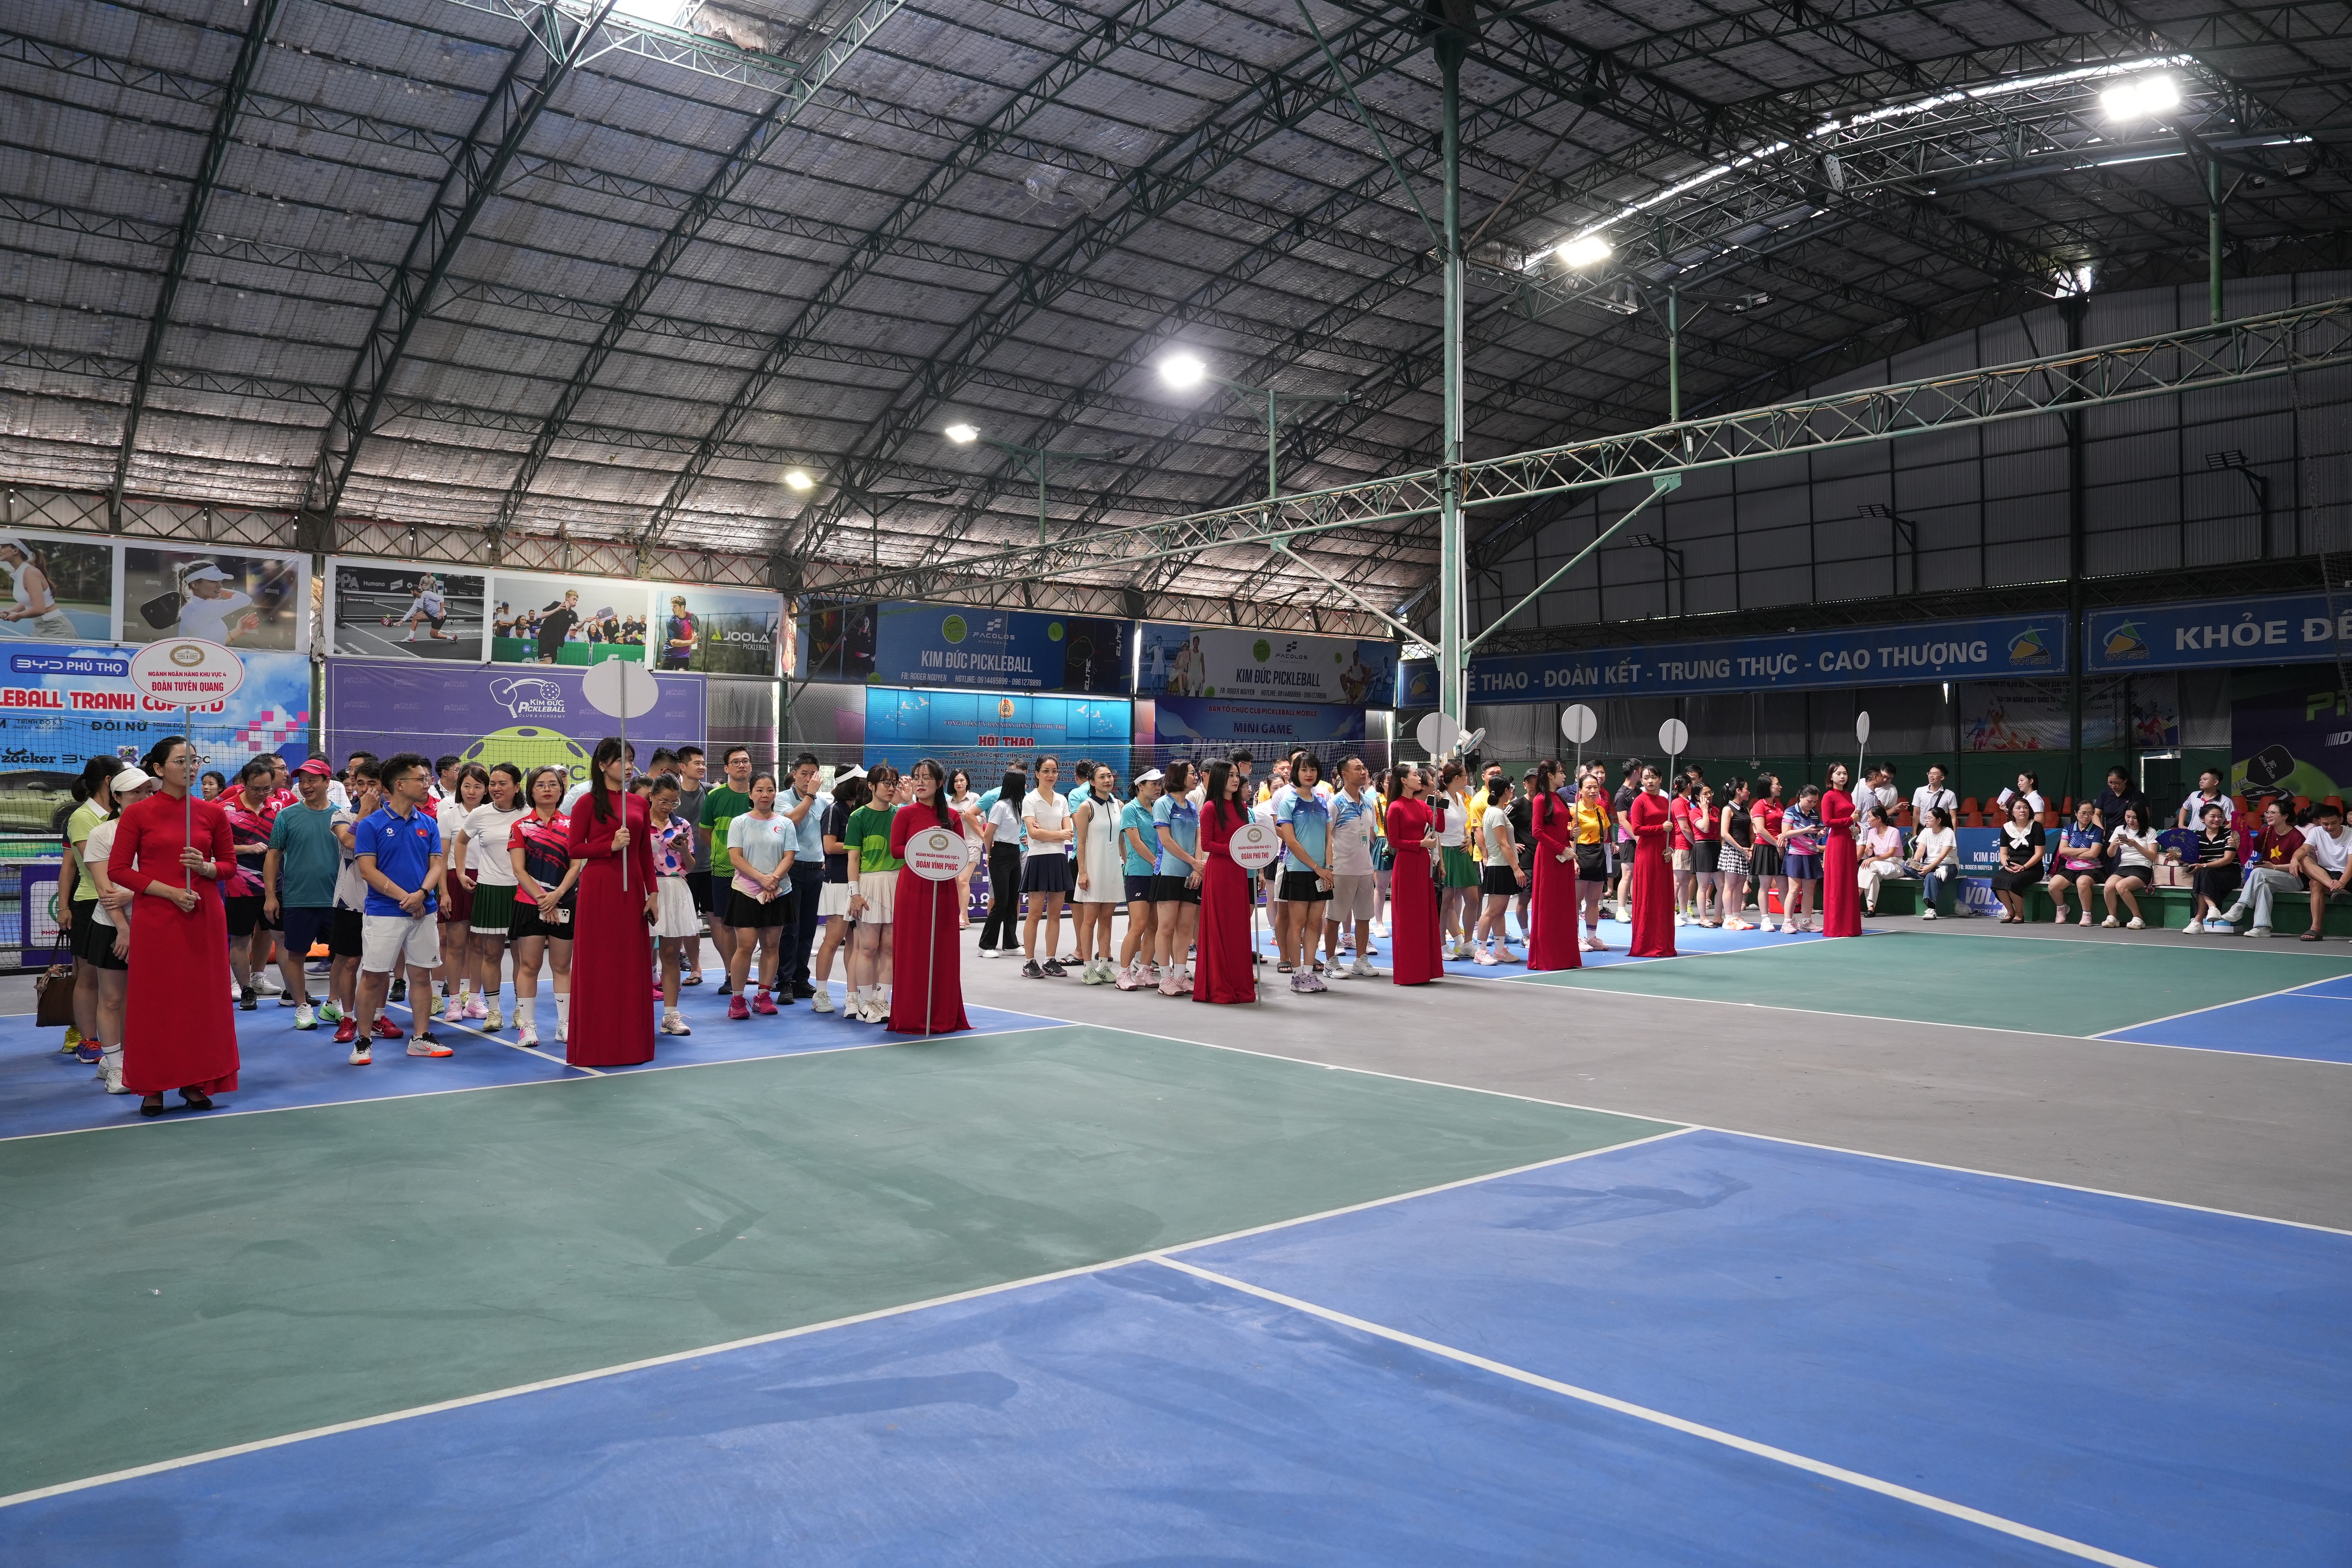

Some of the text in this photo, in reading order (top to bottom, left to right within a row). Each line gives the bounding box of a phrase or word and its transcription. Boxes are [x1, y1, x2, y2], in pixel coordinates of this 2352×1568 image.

[723, 631, 770, 643] JOOLA
[973, 632, 1015, 640] FACOLOS
[2175, 612, 2288, 650] KHỎE
[17, 659, 122, 674] BYD PHÚ THỌ
[921, 649, 1033, 673] KIM ĐỨC PICKLEBALL
[1481, 672, 1528, 691] THAO
[1544, 664, 1599, 688] ĐOÀN
[1605, 657, 1641, 683] KẾT
[1658, 657, 1730, 681] TRUNG
[1737, 653, 1798, 681] THỰC
[1819, 648, 1871, 672] CAO
[1878, 640, 1988, 671] THƯỢNG
[901, 672, 909, 680] FB:
[927, 673, 947, 681] NGUYEN
[955, 675, 976, 683] HOTLINE:
[977, 676, 1008, 684] 0914465899
[1012, 678, 1042, 687] 0961278899
[1236, 667, 1320, 687] KIM ĐỨC PICKLEBALL
[152, 680, 224, 692] ĐOÀN TUYÊN QUANG
[70, 692, 135, 710] TRANH
[518, 702, 566, 713] PICKLEBALL
[1222, 704, 1231, 712] TỔ
[1233, 721, 1293, 734] MINI GAME
[978, 733, 1035, 749] HỘI THAO
[1973, 851, 1988, 862] KIM
[916, 860, 958, 871] ĐOÀN VĨNH PHÚC
